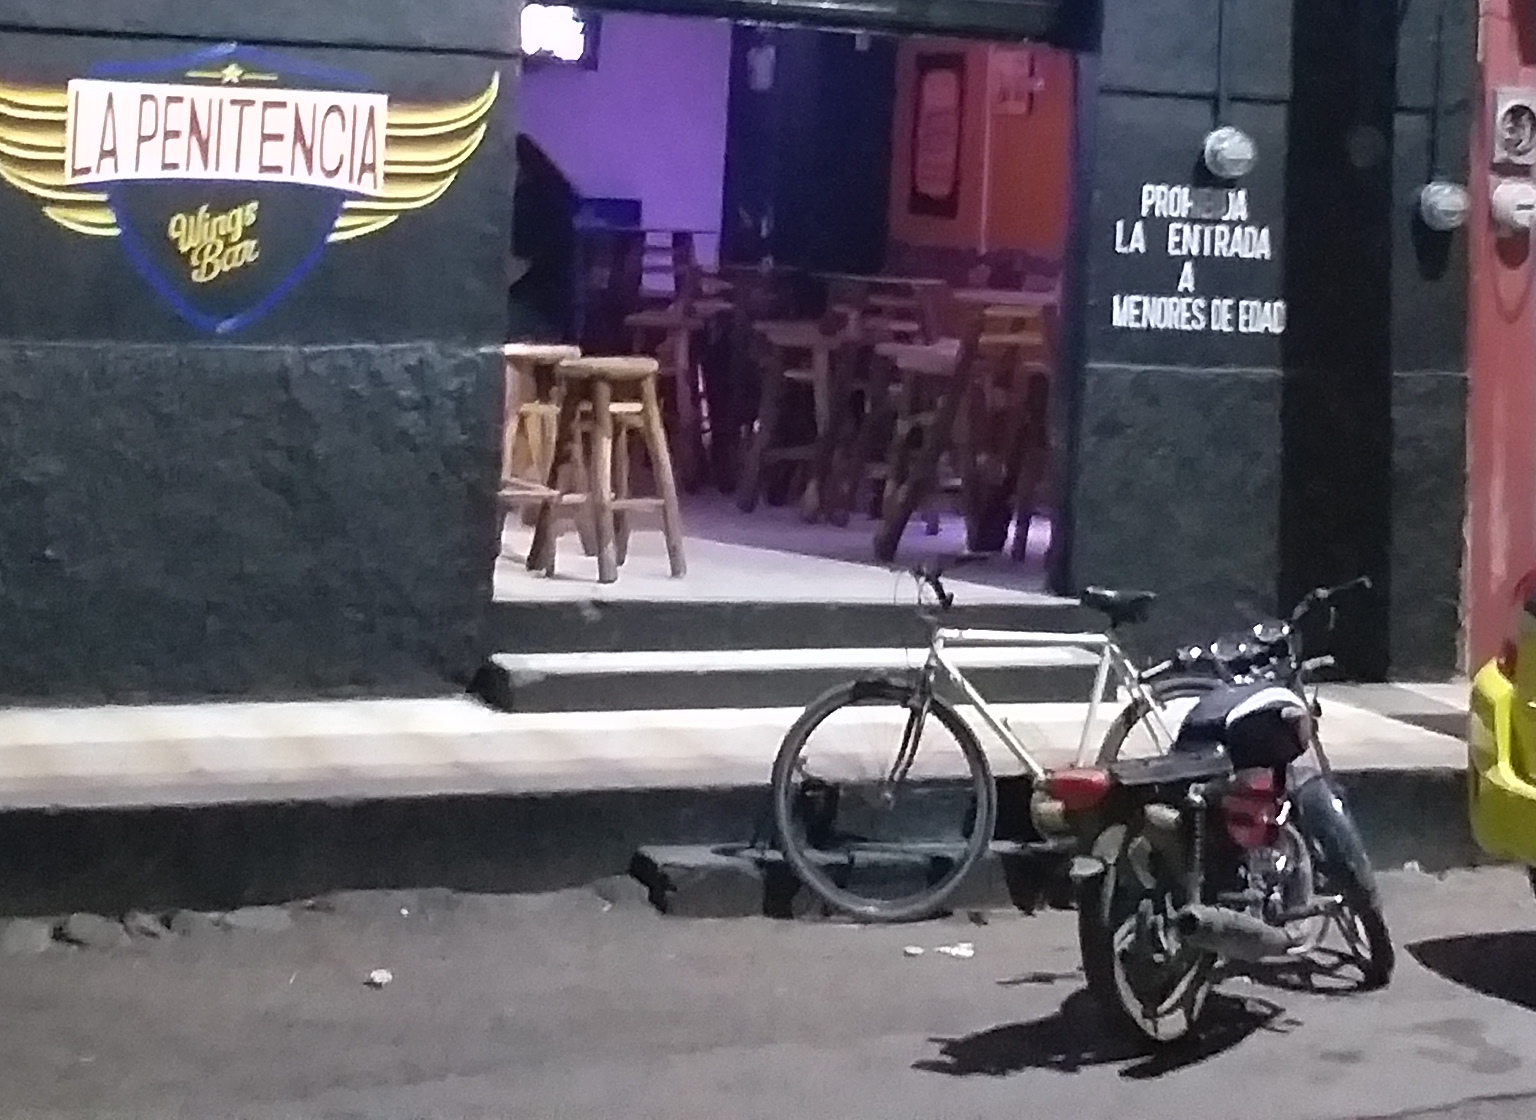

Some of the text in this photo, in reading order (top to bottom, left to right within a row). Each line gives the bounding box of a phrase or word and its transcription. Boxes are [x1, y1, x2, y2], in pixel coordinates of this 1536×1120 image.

[70, 90, 378, 190] LA PENITENCIA
[1141, 182, 1248, 221] PROHBDA
[167, 199, 260, 254] Wings
[1114, 218, 1272, 261] LA ENTRADA
[190, 238, 261, 283] Bar
[1176, 260, 1196, 293] A
[1112, 294, 1288, 335] MENORES DE EDAD
